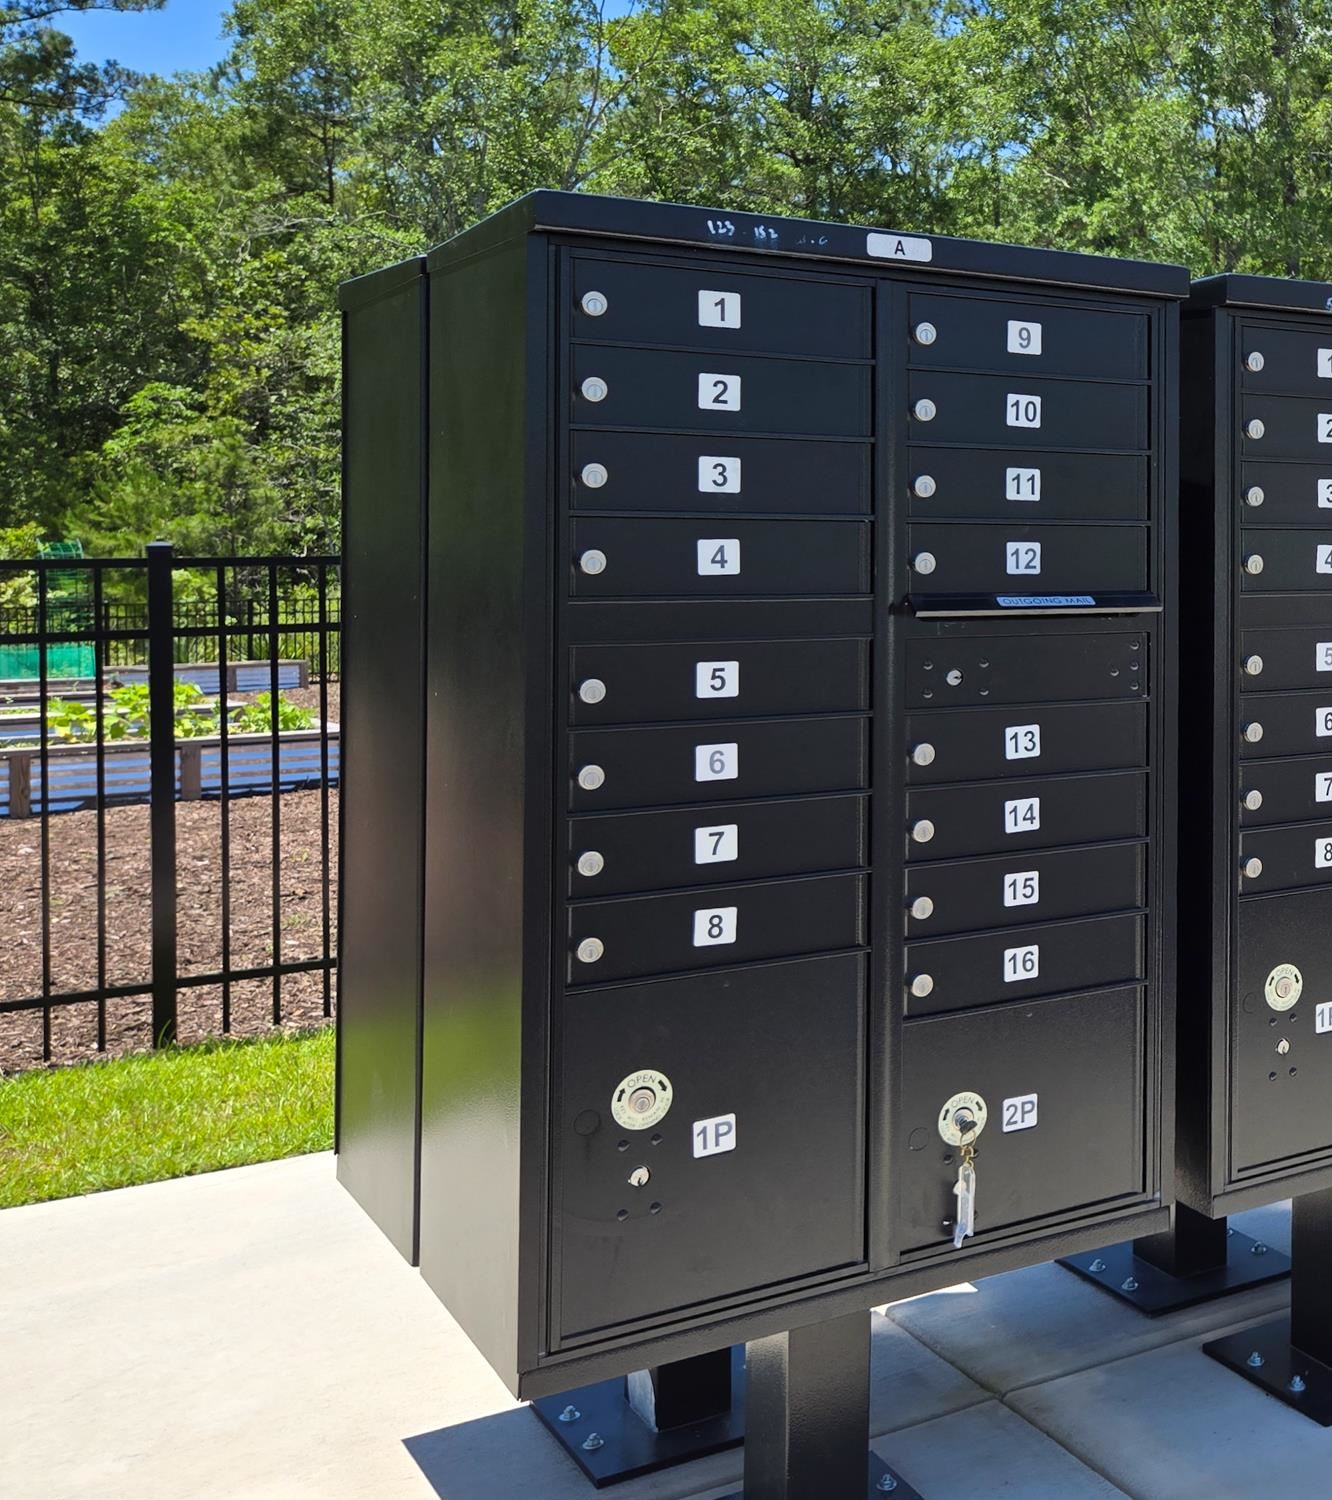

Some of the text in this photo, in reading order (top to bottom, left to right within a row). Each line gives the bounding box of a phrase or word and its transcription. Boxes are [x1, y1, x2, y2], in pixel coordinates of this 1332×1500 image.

[706, 219, 735, 237] 123
[893, 239, 906, 257] A
[713, 297, 726, 322] 1
[1018, 326, 1032, 350] 9
[711, 379, 729, 405] 2
[1010, 399, 1038, 423] 10
[711, 462, 728, 488] 3
[1011, 472, 1036, 496] 11
[710, 544, 729, 569] 4
[1010, 547, 1037, 570] 12
[1002, 597, 1062, 606] OUTGOING
[709, 667, 727, 692] 5
[1009, 730, 1037, 754] 13
[708, 749, 726, 775] 6
[1008, 802, 1037, 828] 14
[708, 830, 725, 856] 7
[1008, 876, 1035, 901] 15
[707, 914, 724, 939] 8
[1008, 950, 1035, 975] 16
[626, 1073, 657, 1088] OPEN
[951, 1095, 975, 1108] OPEN
[1004, 1099, 1036, 1127] 2P
[696, 1120, 733, 1151] 1P
